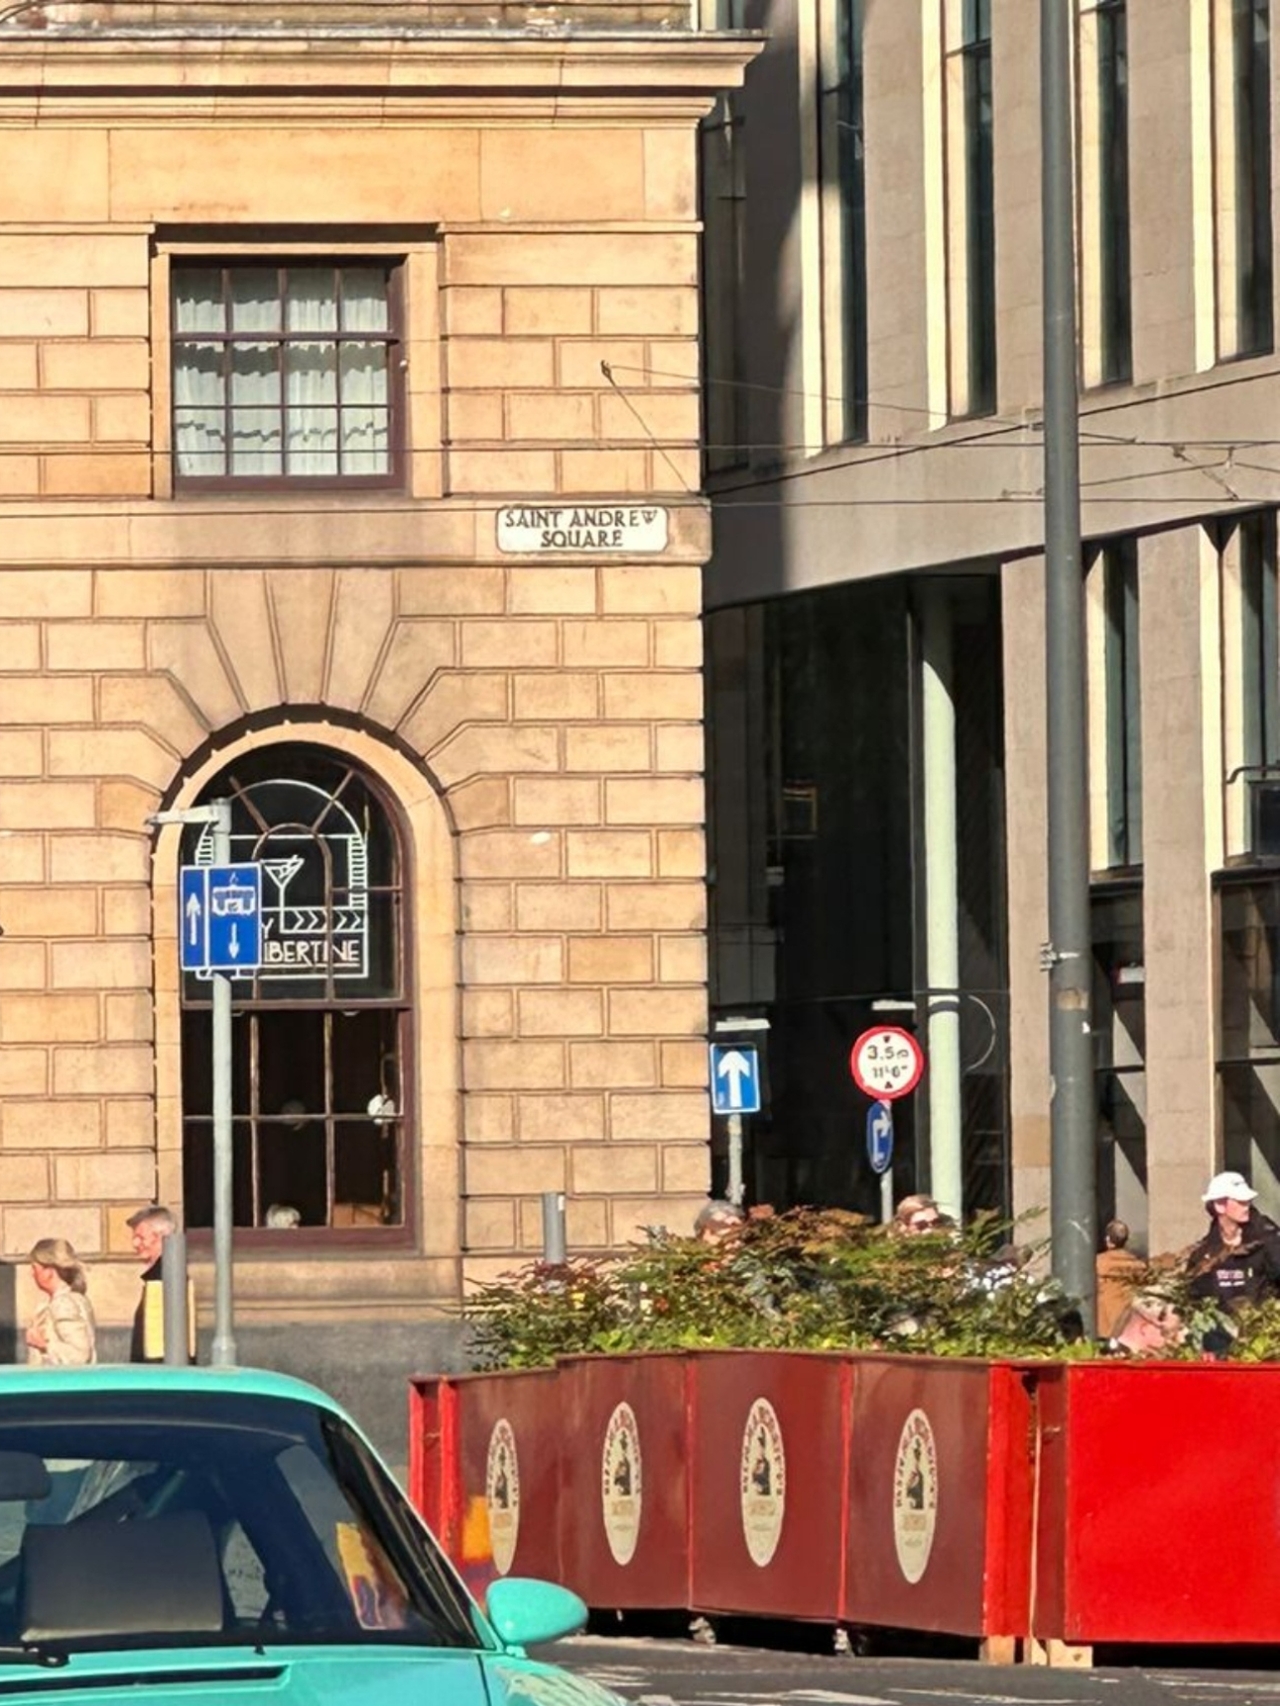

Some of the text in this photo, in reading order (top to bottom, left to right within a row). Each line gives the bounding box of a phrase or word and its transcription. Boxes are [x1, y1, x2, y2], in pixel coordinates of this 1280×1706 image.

[505, 509, 658, 528] SAINT ANDREW
[540, 529, 624, 548] SQUARE
[263, 939, 360, 964] IBERTINE
